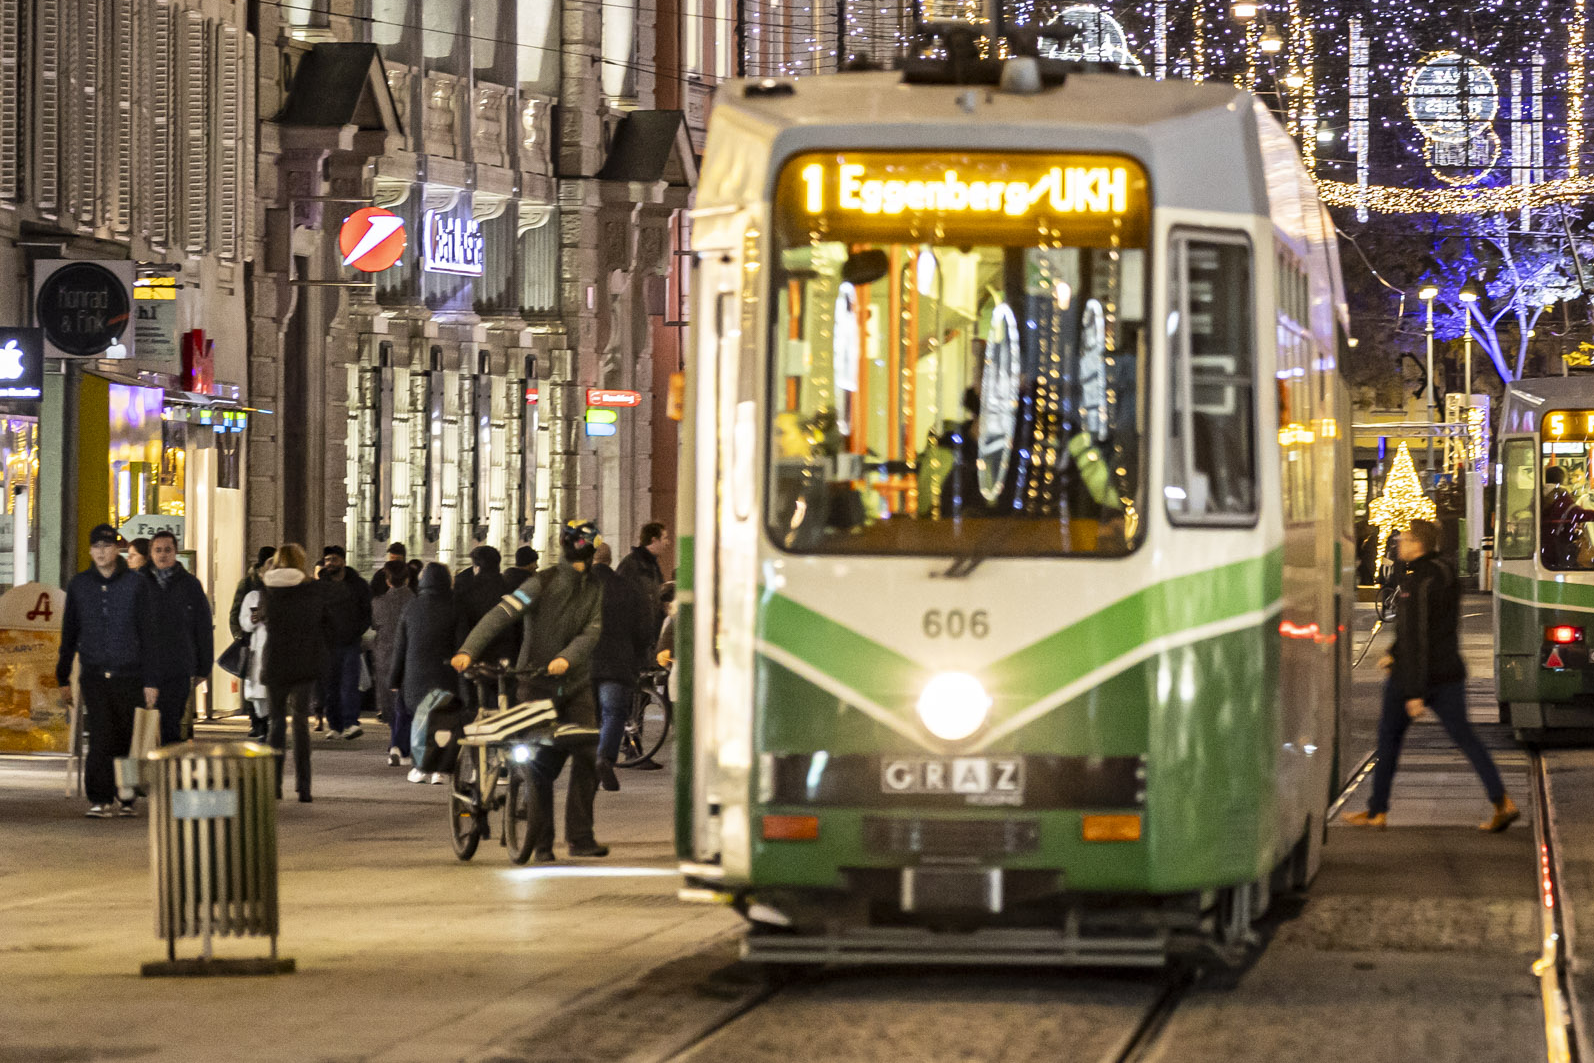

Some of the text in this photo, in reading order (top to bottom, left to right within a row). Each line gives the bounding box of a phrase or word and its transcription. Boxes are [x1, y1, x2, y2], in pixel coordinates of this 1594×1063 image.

[801, 163, 1128, 215] 1 Eggenberg/UKH
[1551, 414, 1564, 435] 5
[922, 608, 990, 639] 606
[885, 758, 1017, 791] GRAZ
